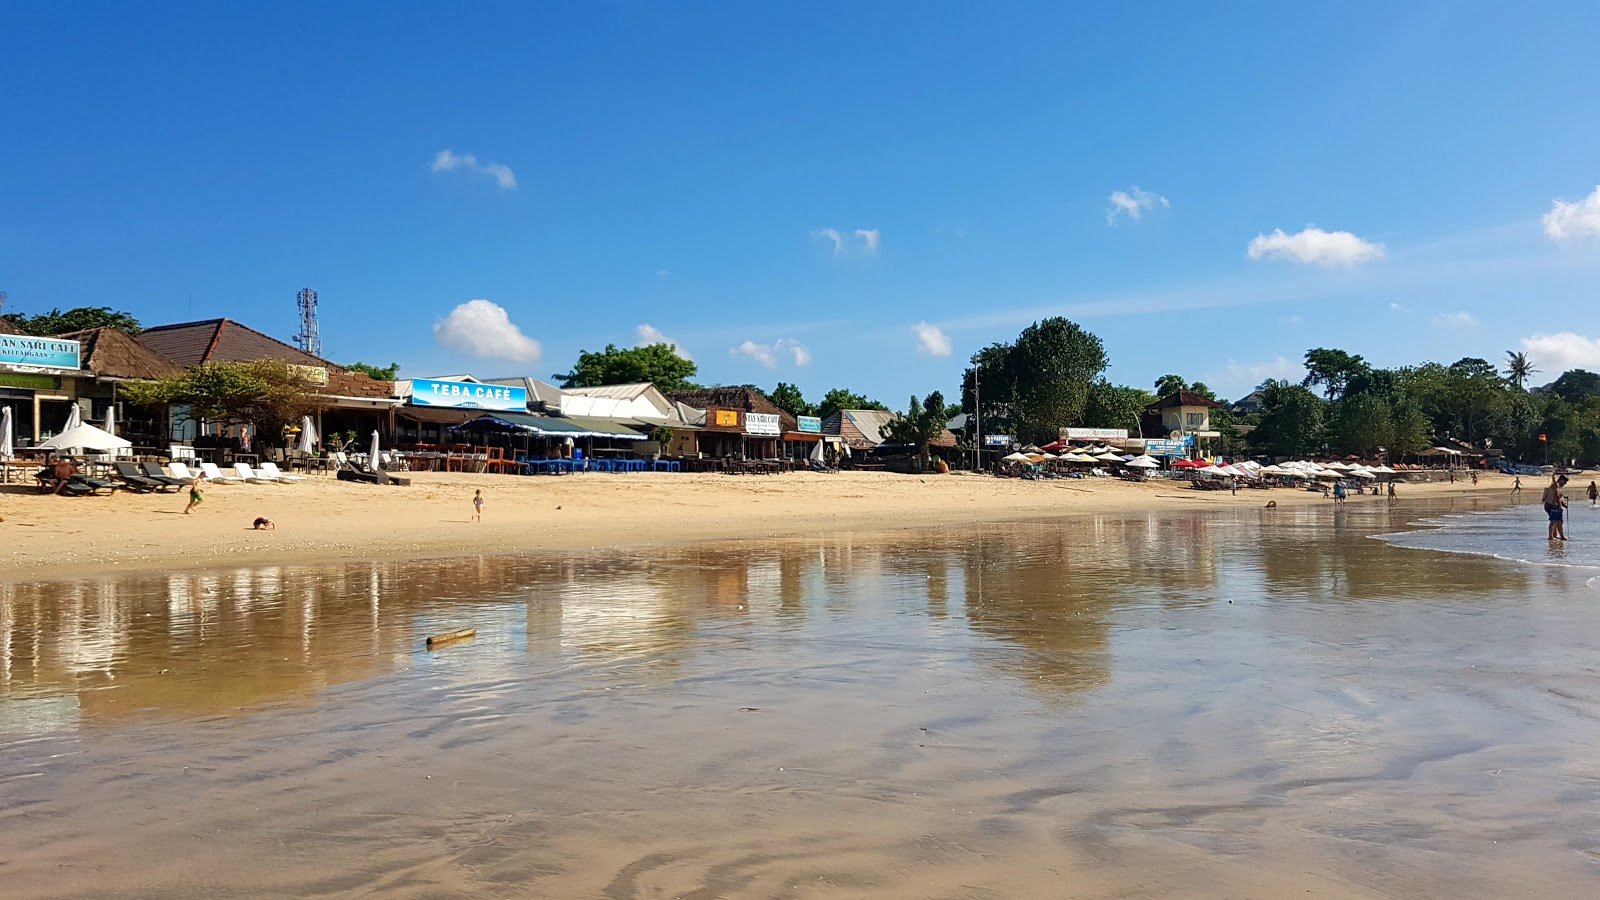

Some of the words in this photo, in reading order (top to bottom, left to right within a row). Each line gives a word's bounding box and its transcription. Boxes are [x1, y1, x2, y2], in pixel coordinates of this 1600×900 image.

[0, 338, 16, 347] AN
[20, 340, 47, 350] SARI
[50, 343, 76, 353] CAFE
[0, 349, 48, 358] KELUARGAAN
[431, 383, 471, 397] TEBA
[475, 387, 511, 401] CAFÉ
